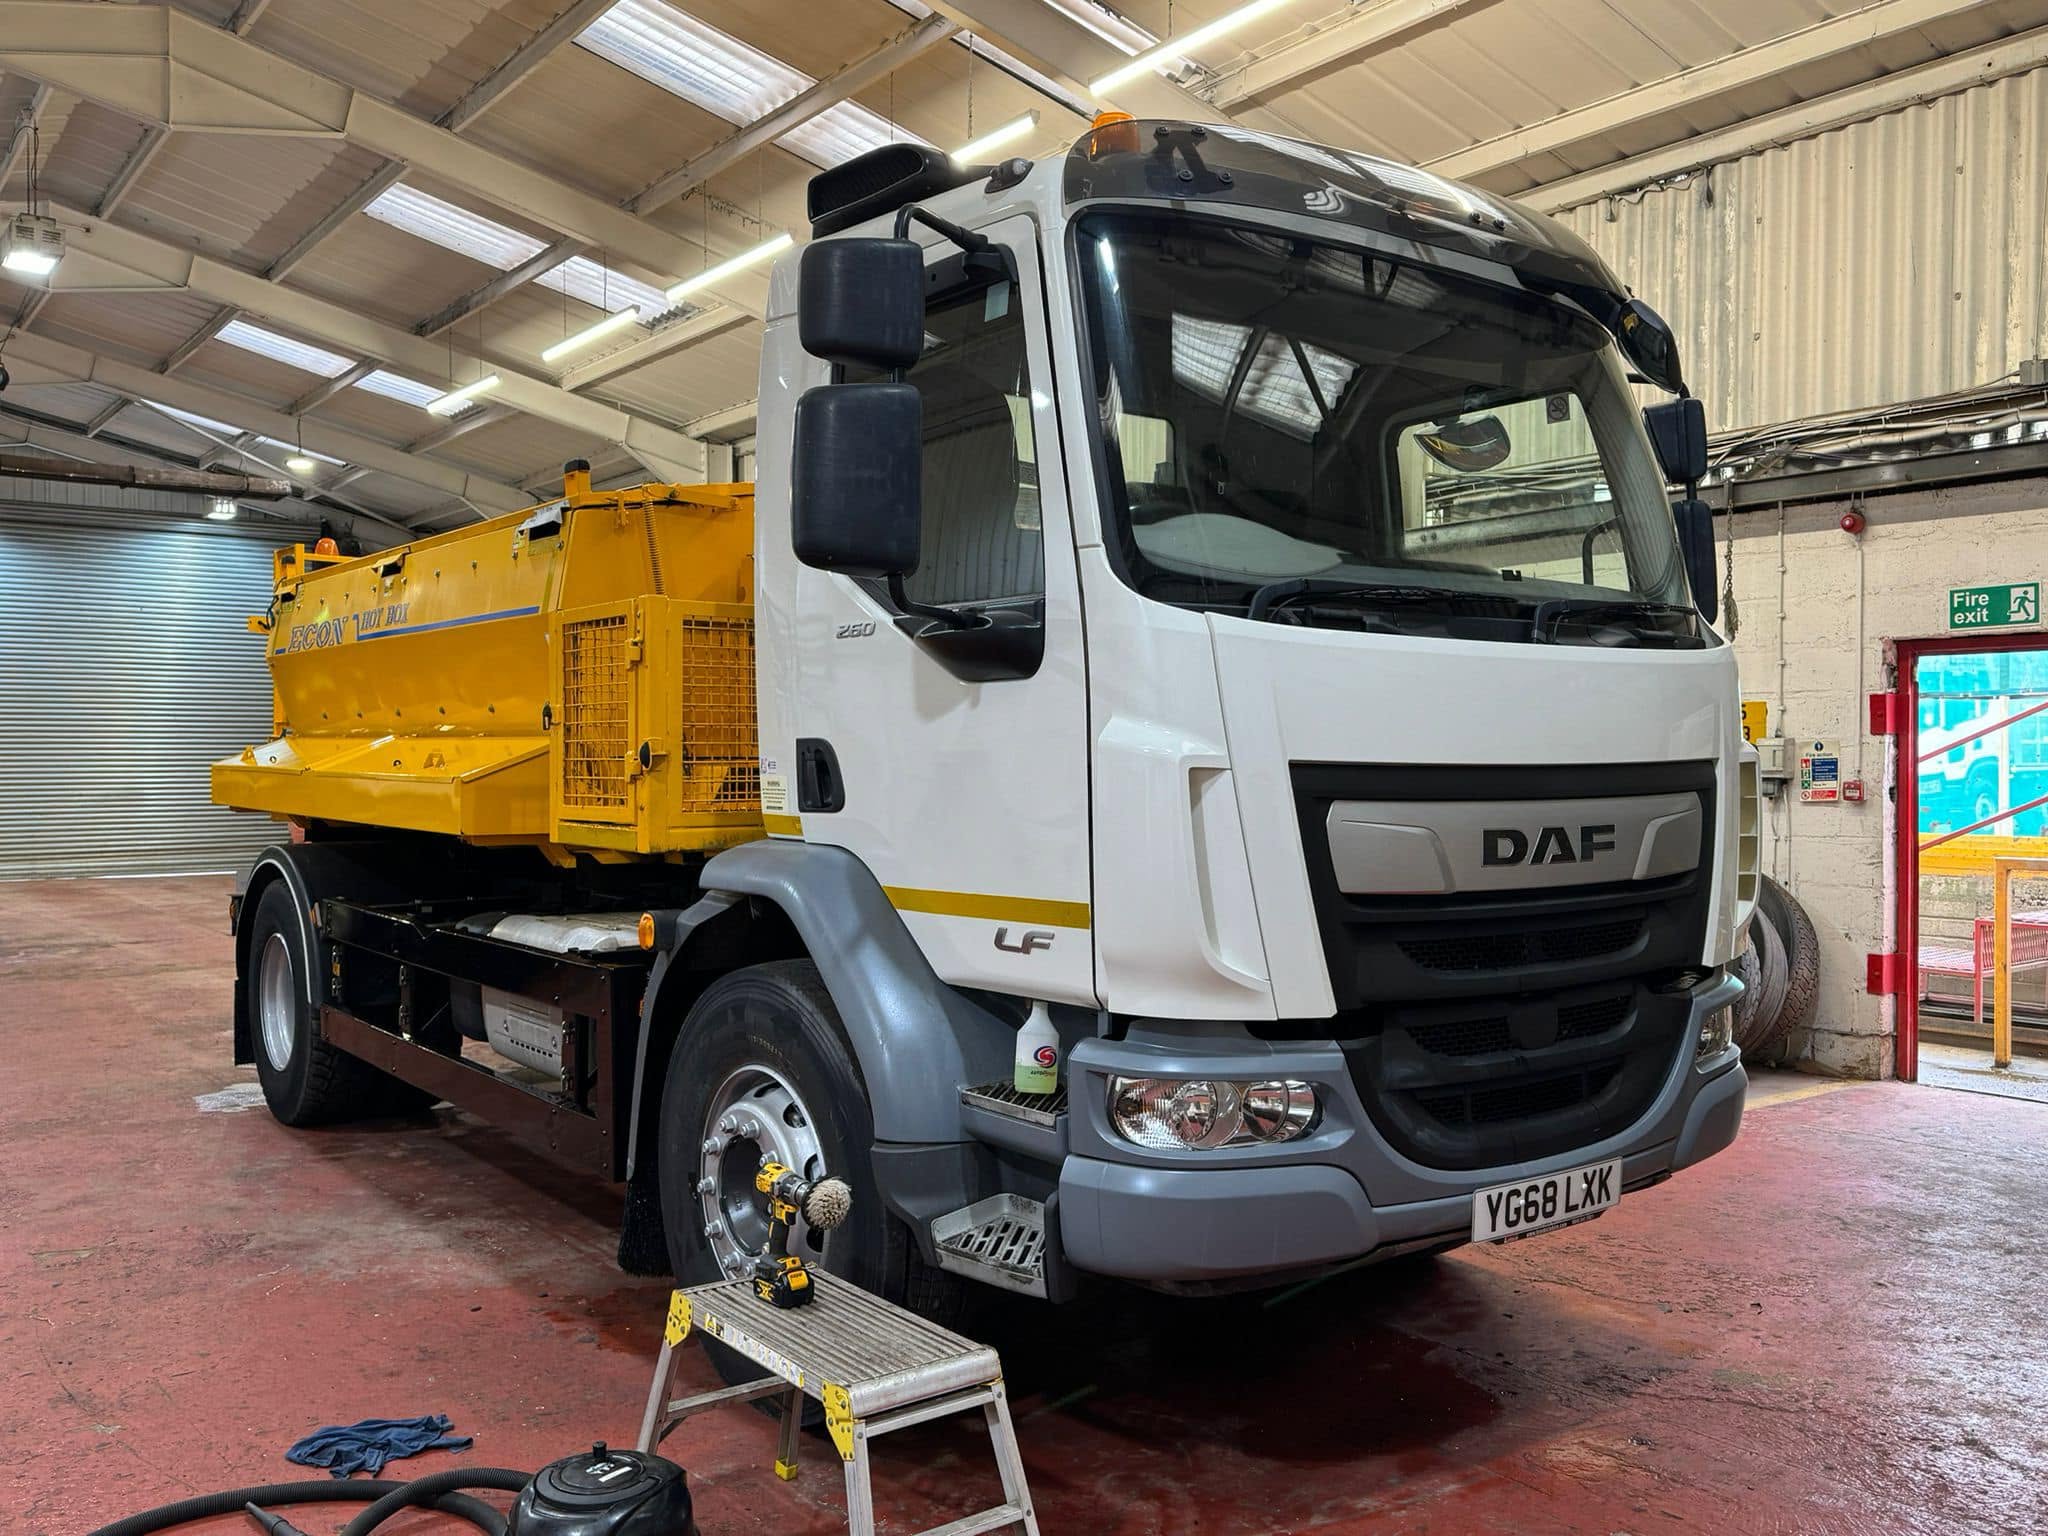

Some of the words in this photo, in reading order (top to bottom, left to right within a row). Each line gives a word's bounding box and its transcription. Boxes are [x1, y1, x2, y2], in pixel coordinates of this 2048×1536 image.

[1953, 591, 1989, 607] Fire
[361, 608, 383, 630] HOT
[385, 602, 409, 626] BOX
[1954, 607, 1989, 624] exit
[288, 616, 348, 653] ECON
[836, 621, 876, 639] 260
[1482, 825, 1616, 866] DAF
[994, 927, 1055, 955] LF
[1486, 1182, 1558, 1232] YG68
[1564, 1165, 1613, 1213] LXK
